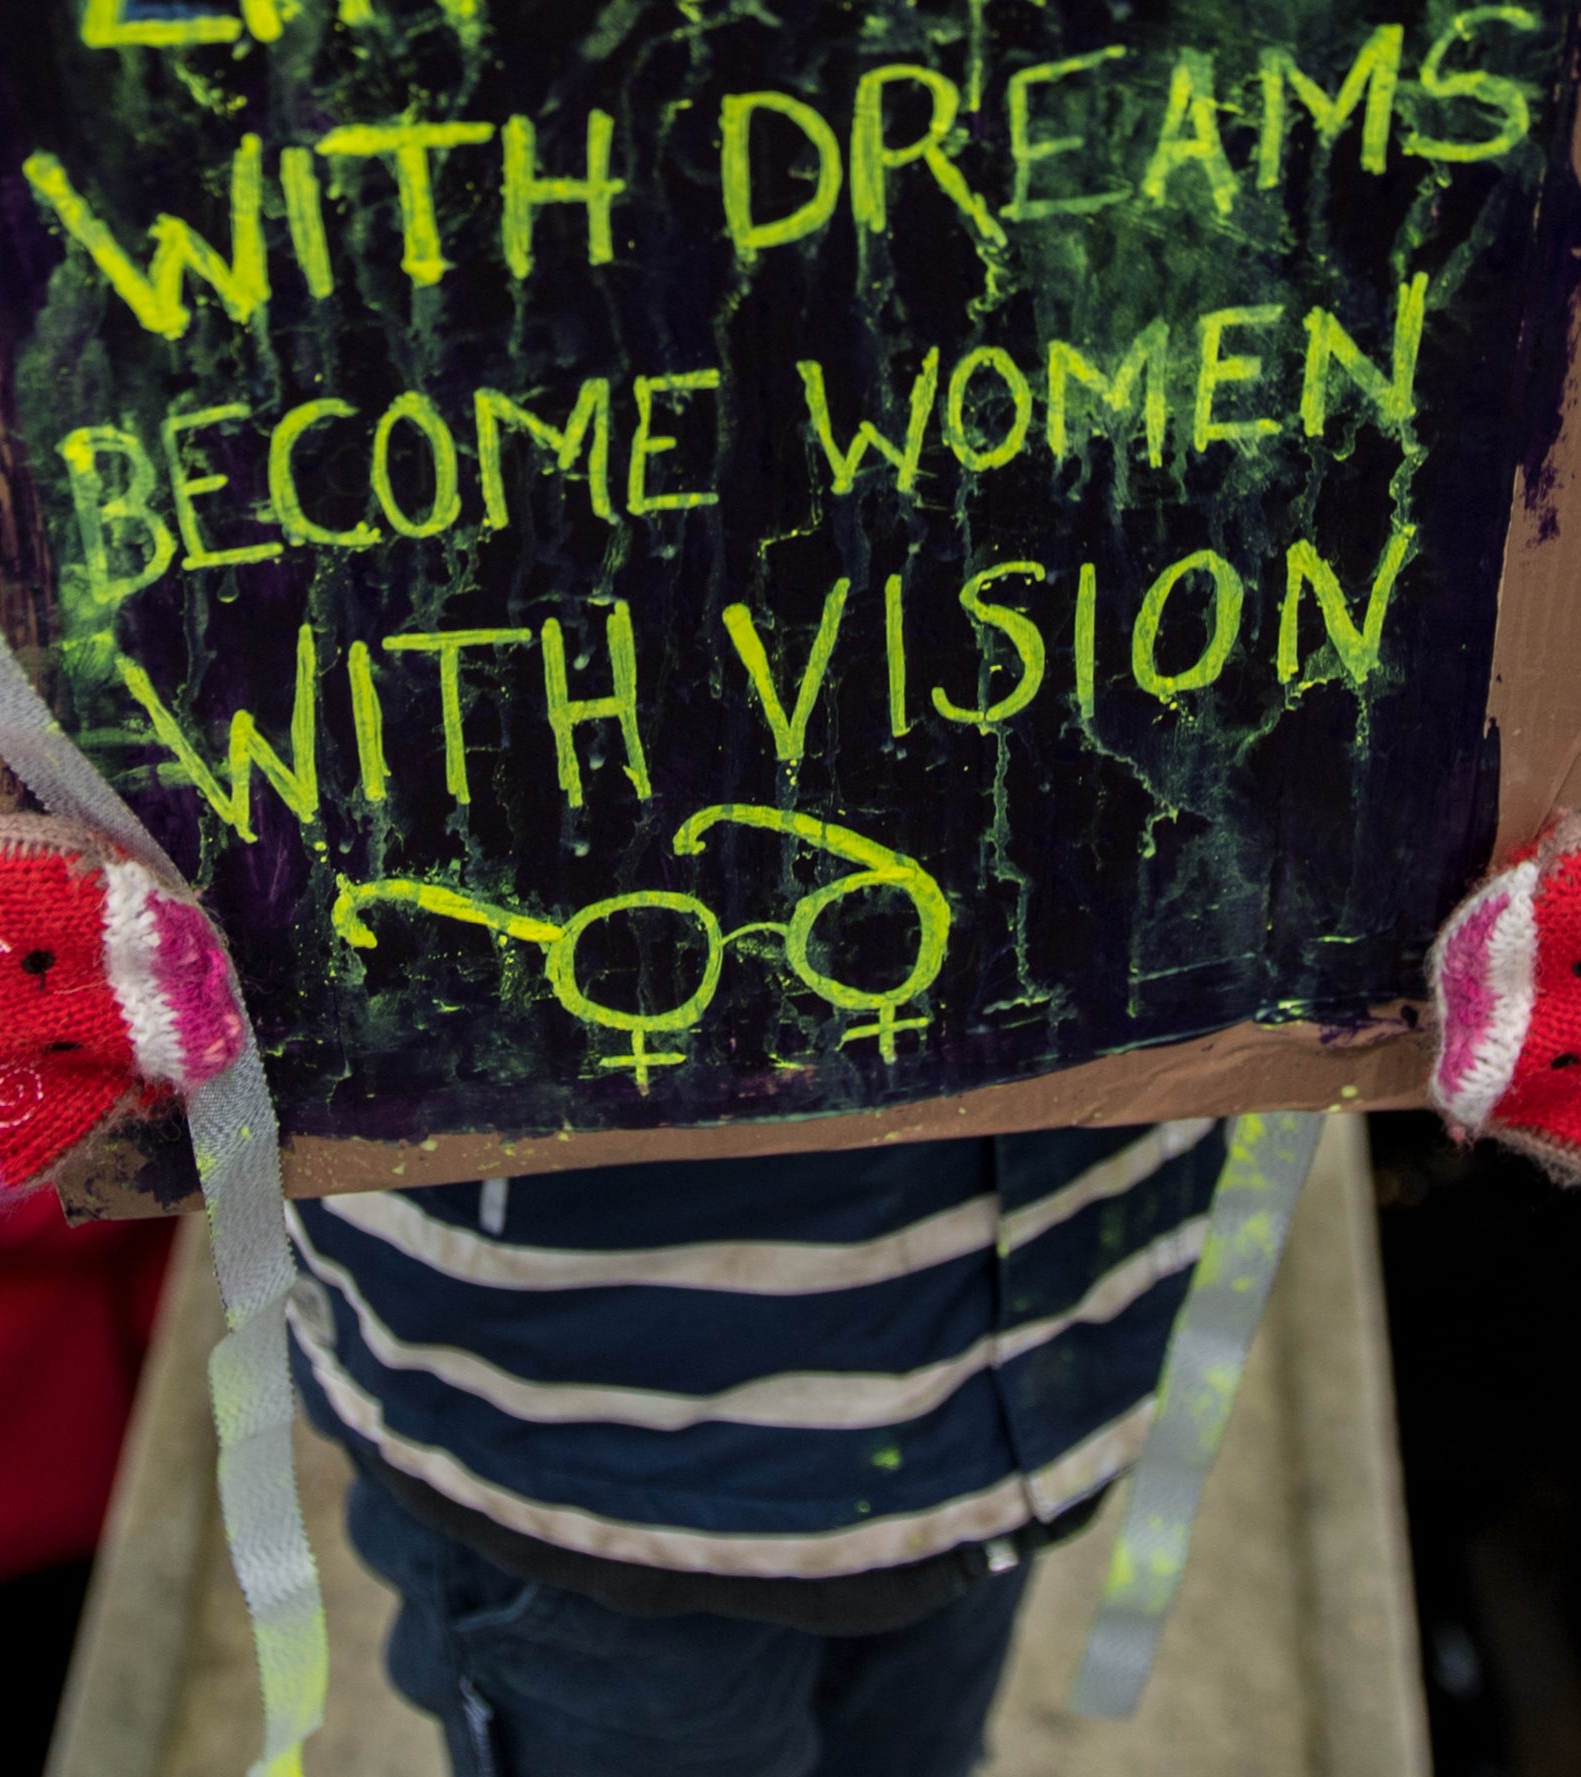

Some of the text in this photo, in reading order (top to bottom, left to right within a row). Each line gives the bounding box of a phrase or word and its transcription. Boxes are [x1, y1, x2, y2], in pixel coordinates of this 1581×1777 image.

[24, 6, 1532, 338] WITH DREAMS
[59, 272, 1429, 606] BECOME WOMEN
[116, 524, 1417, 842] WITH VISION
